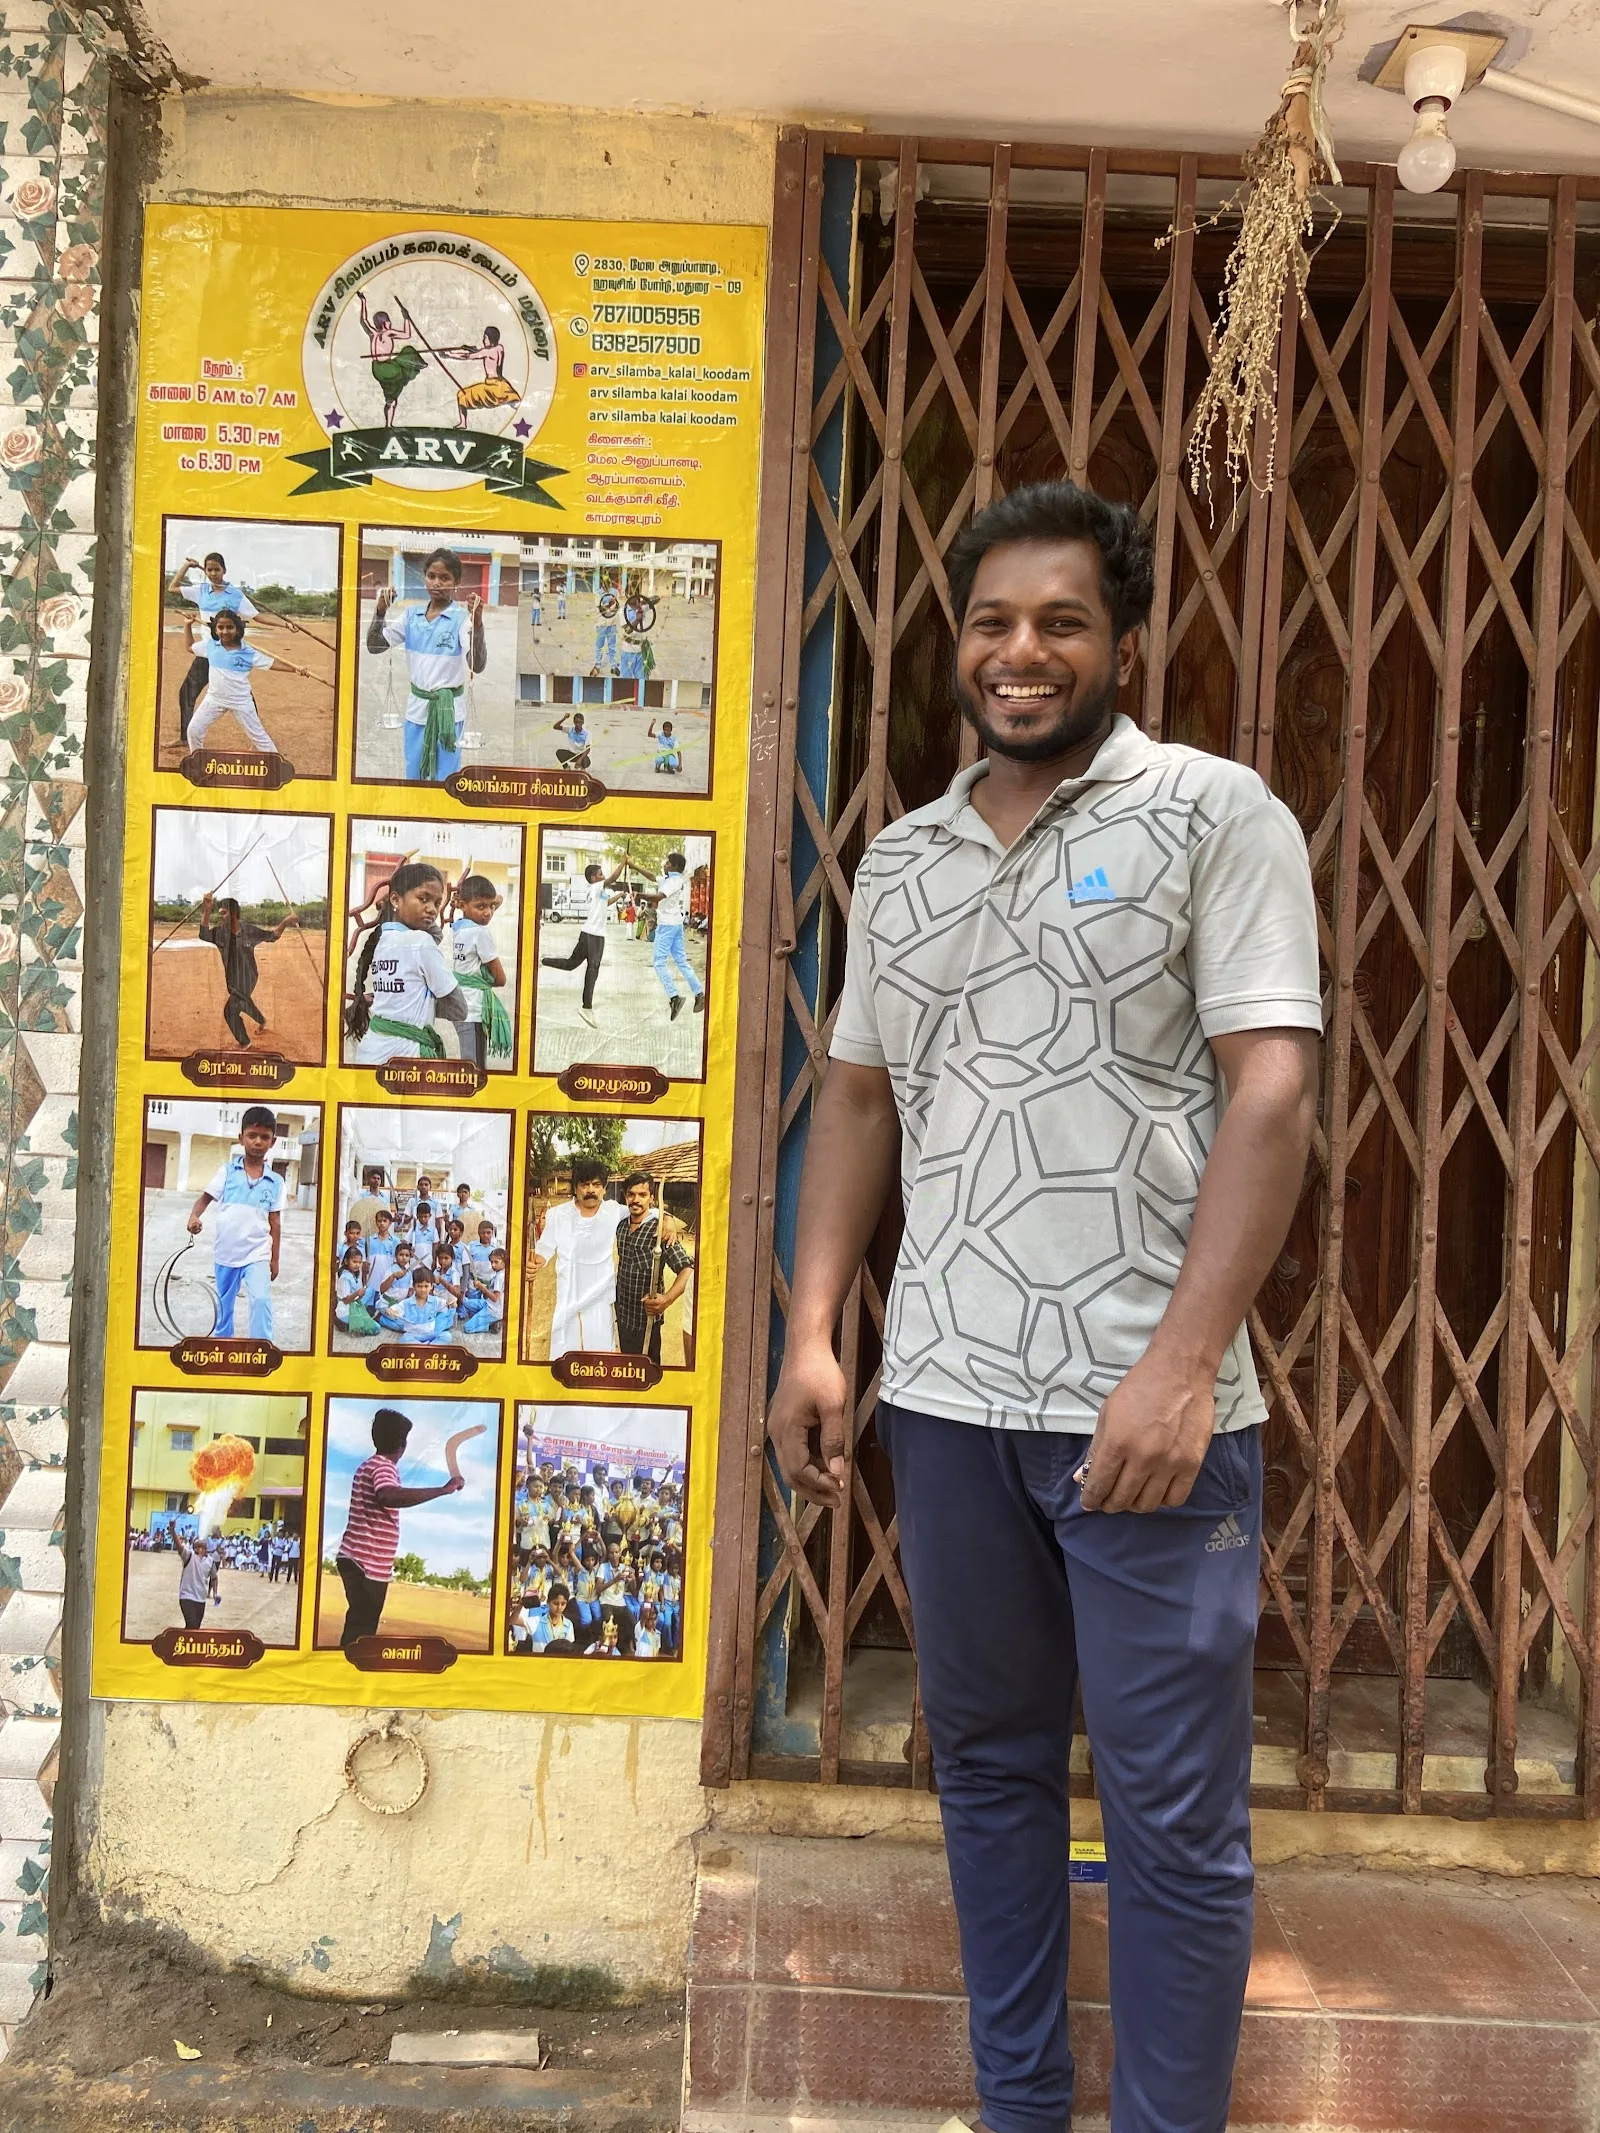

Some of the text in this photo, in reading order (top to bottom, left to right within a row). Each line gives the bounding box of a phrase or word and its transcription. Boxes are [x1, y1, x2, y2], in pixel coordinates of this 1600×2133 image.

[594, 260, 626, 272] 2830,
[630, 258, 655, 271] மேல
[728, 282, 742, 294] 09
[314, 241, 550, 361] ARV சிலம்பம் கலைக் கூடம் மதுரை
[593, 305, 700, 325] 7871005956
[592, 334, 700, 354] 6382517900
[591, 364, 750, 381] arv_silamba_kalai_koodam
[150, 385, 296, 406] காலை 6 AM to 7 AM
[590, 387, 738, 403] arv silamba kalai koodam
[589, 410, 737, 425] arv silamba kalai koodam
[163, 425, 280, 445] மாலை 5.30 PM
[588, 432, 645, 446] கிளைகள்
[380, 436, 476, 465] ARV
[587, 454, 618, 465] மேல
[181, 453, 261, 472] to 6.30 PM
[585, 513, 662, 526] காமராஜபுரம்
[205, 758, 269, 777] சிலம்பம்
[455, 775, 589, 797] அலங்கார சிலம்பம்
[198, 1059, 278, 1079] இரட்டை கம்பு
[384, 1066, 478, 1088] மான் கொம்பு
[574, 1076, 652, 1096] அடிமுறை
[181, 1346, 268, 1366] சுருள் வாள்
[381, 1351, 462, 1371] வாள் வீச்சு
[570, 1361, 646, 1382] வேல் கம்பு
[1205, 1534, 1251, 1553] adidas
[173, 1637, 245, 1658] தீப்பந்தம்
[381, 1646, 422, 1661] வளரி
